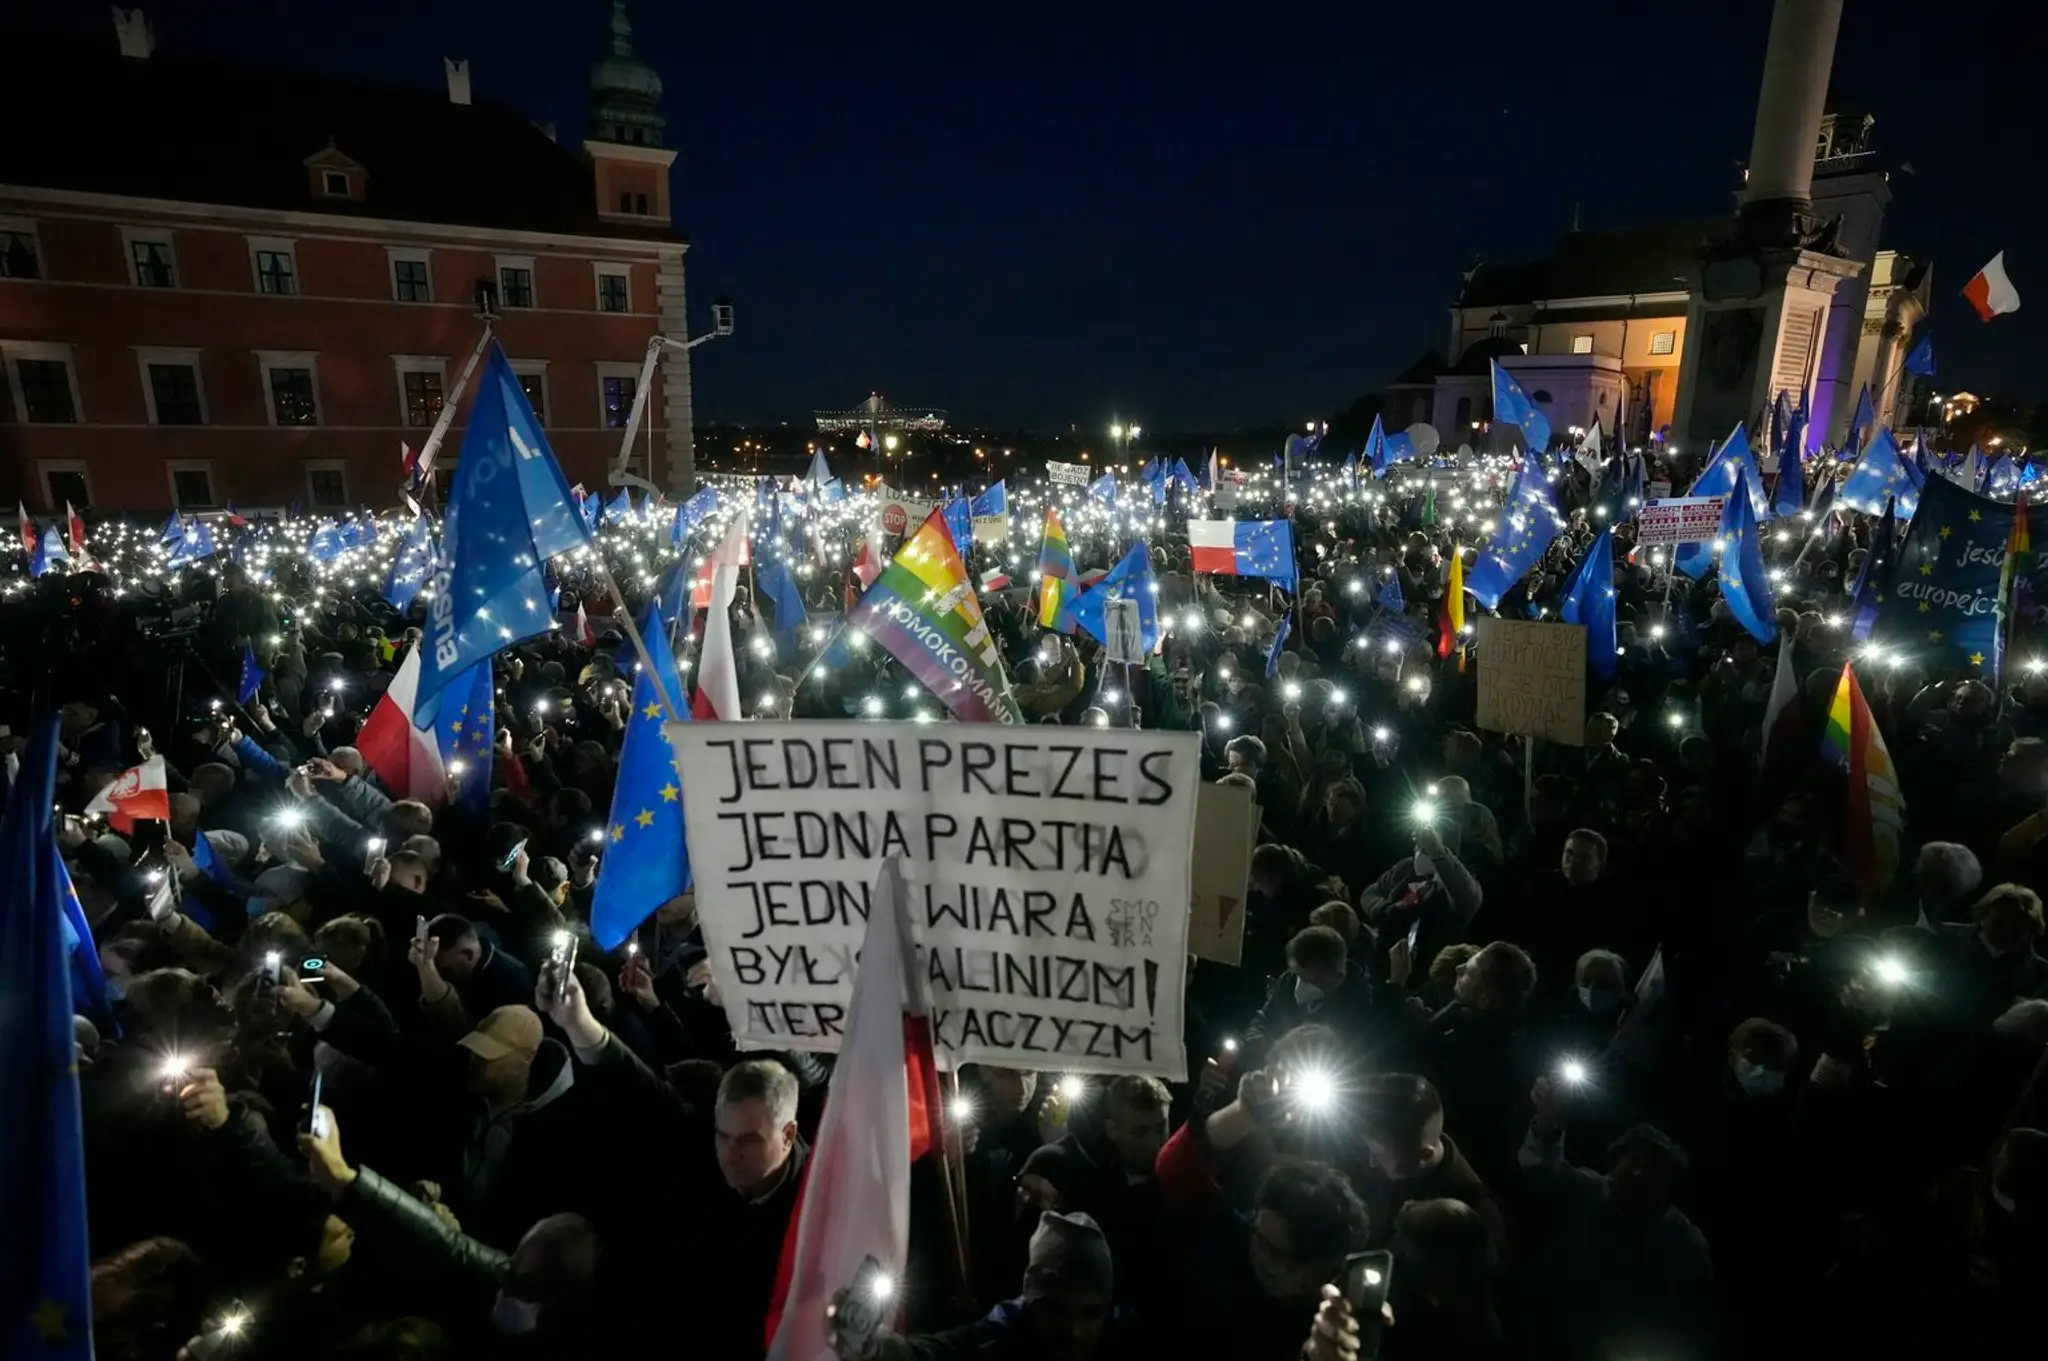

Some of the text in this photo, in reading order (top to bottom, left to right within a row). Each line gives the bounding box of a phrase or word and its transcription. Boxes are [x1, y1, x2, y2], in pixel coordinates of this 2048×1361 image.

[884, 512, 906, 525] STOP
[881, 596, 1014, 725] HOMOKOMAND
[706, 738, 1174, 805] JEDEN PREZES
[717, 810, 1133, 879] JEDNA PARTIA
[727, 880, 1096, 942] JEDN WIARA
[728, 944, 1159, 1026] BYŁ ALINIZM!
[757, 1000, 1152, 1061] TER KACZYZM
